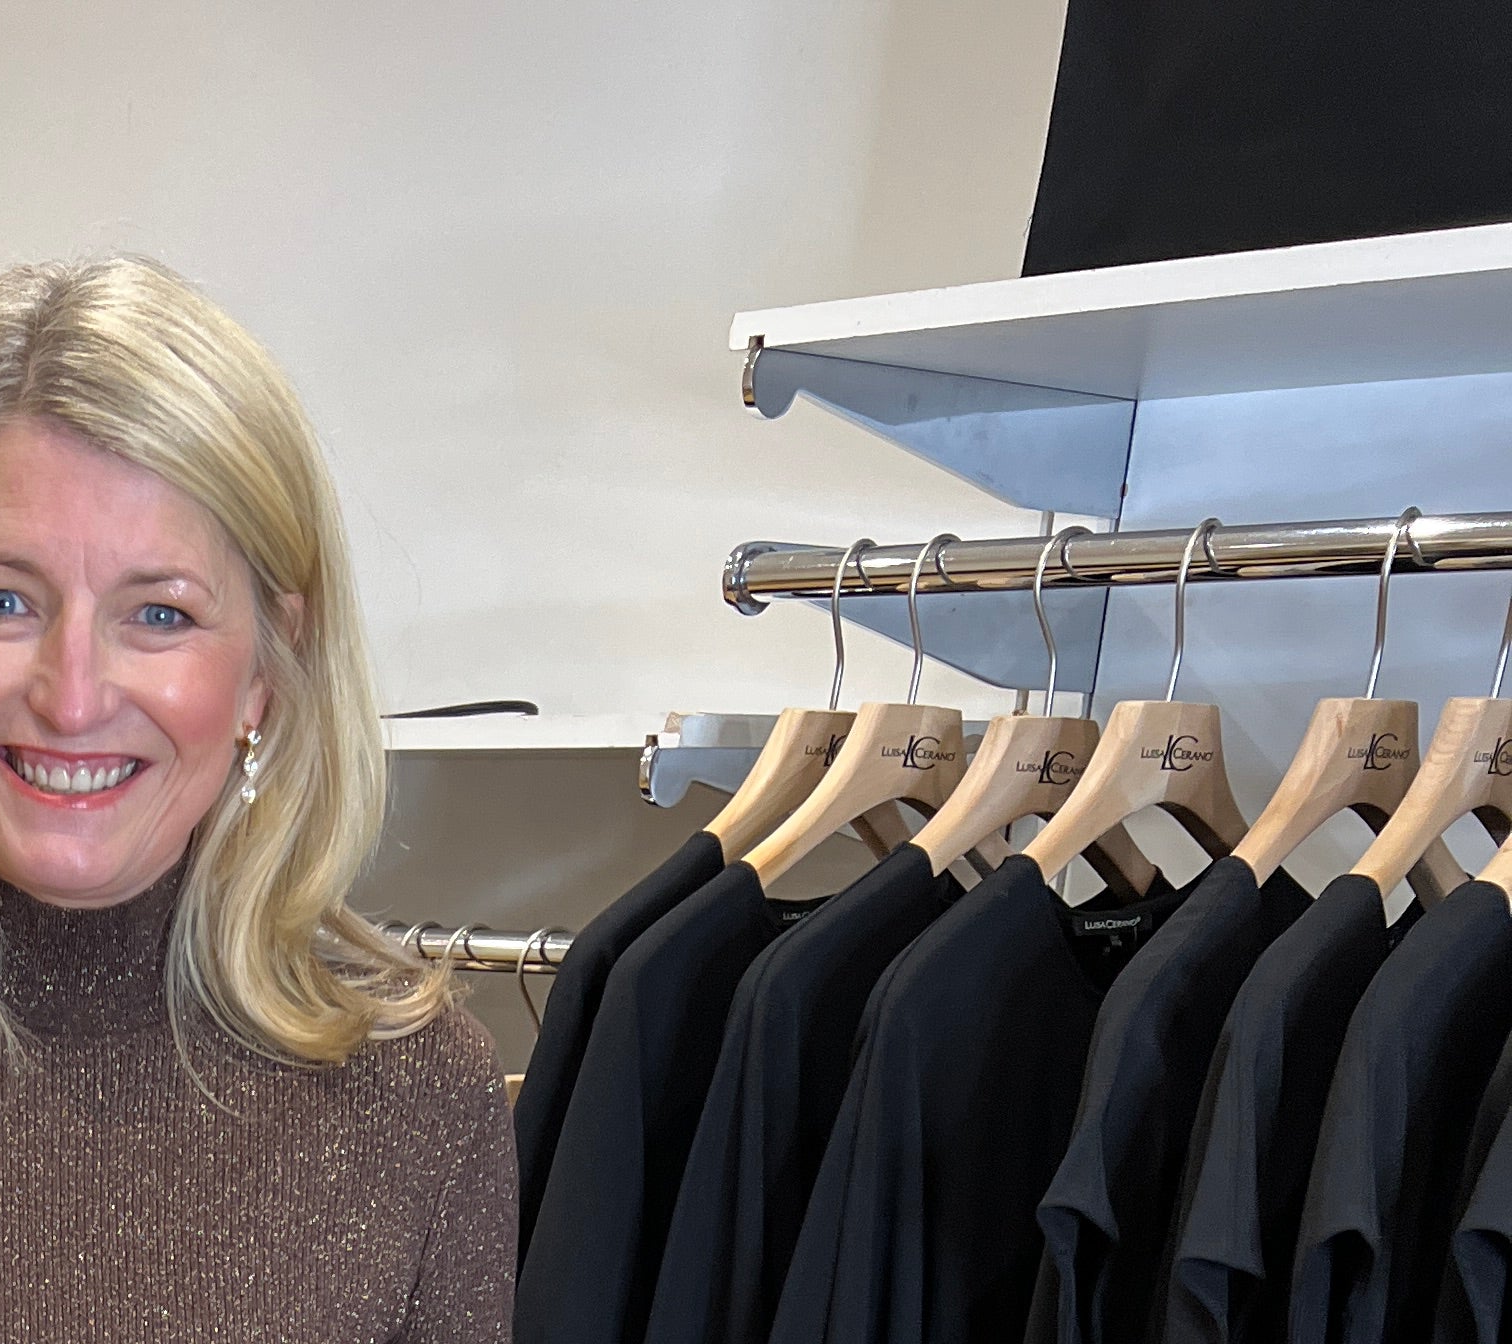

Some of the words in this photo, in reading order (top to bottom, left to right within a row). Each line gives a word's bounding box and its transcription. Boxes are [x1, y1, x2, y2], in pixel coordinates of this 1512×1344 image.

[902, 735, 940, 770] LC
[1039, 750, 1074, 785] LC
[1160, 735, 1198, 771] LC
[1363, 733, 1398, 770] LC
